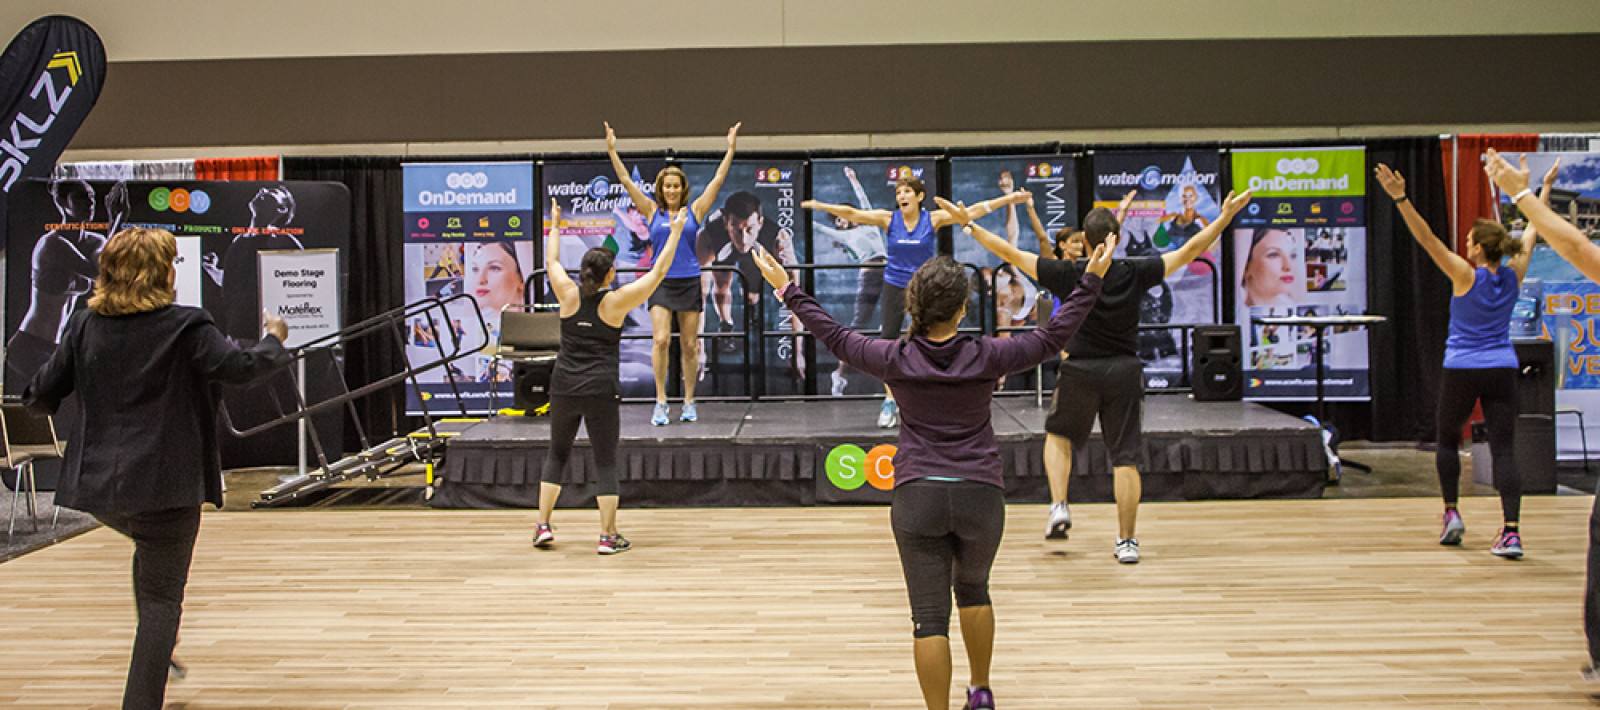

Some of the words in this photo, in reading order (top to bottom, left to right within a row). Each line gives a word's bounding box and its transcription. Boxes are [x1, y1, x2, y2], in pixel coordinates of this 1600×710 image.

[757, 169, 792, 181] SCW
[889, 168, 923, 180] SCW
[1028, 164, 1062, 176] SCW
[1098, 172, 1143, 185] water
[1161, 173, 1215, 185] motion
[1249, 175, 1349, 191] OnDemand
[548, 182, 593, 196] water
[153, 189, 208, 212] SCW
[418, 189, 517, 205] OnDemand
[275, 270, 299, 278] Demo
[301, 269, 325, 278] Stage
[283, 280, 318, 289] Flooring
